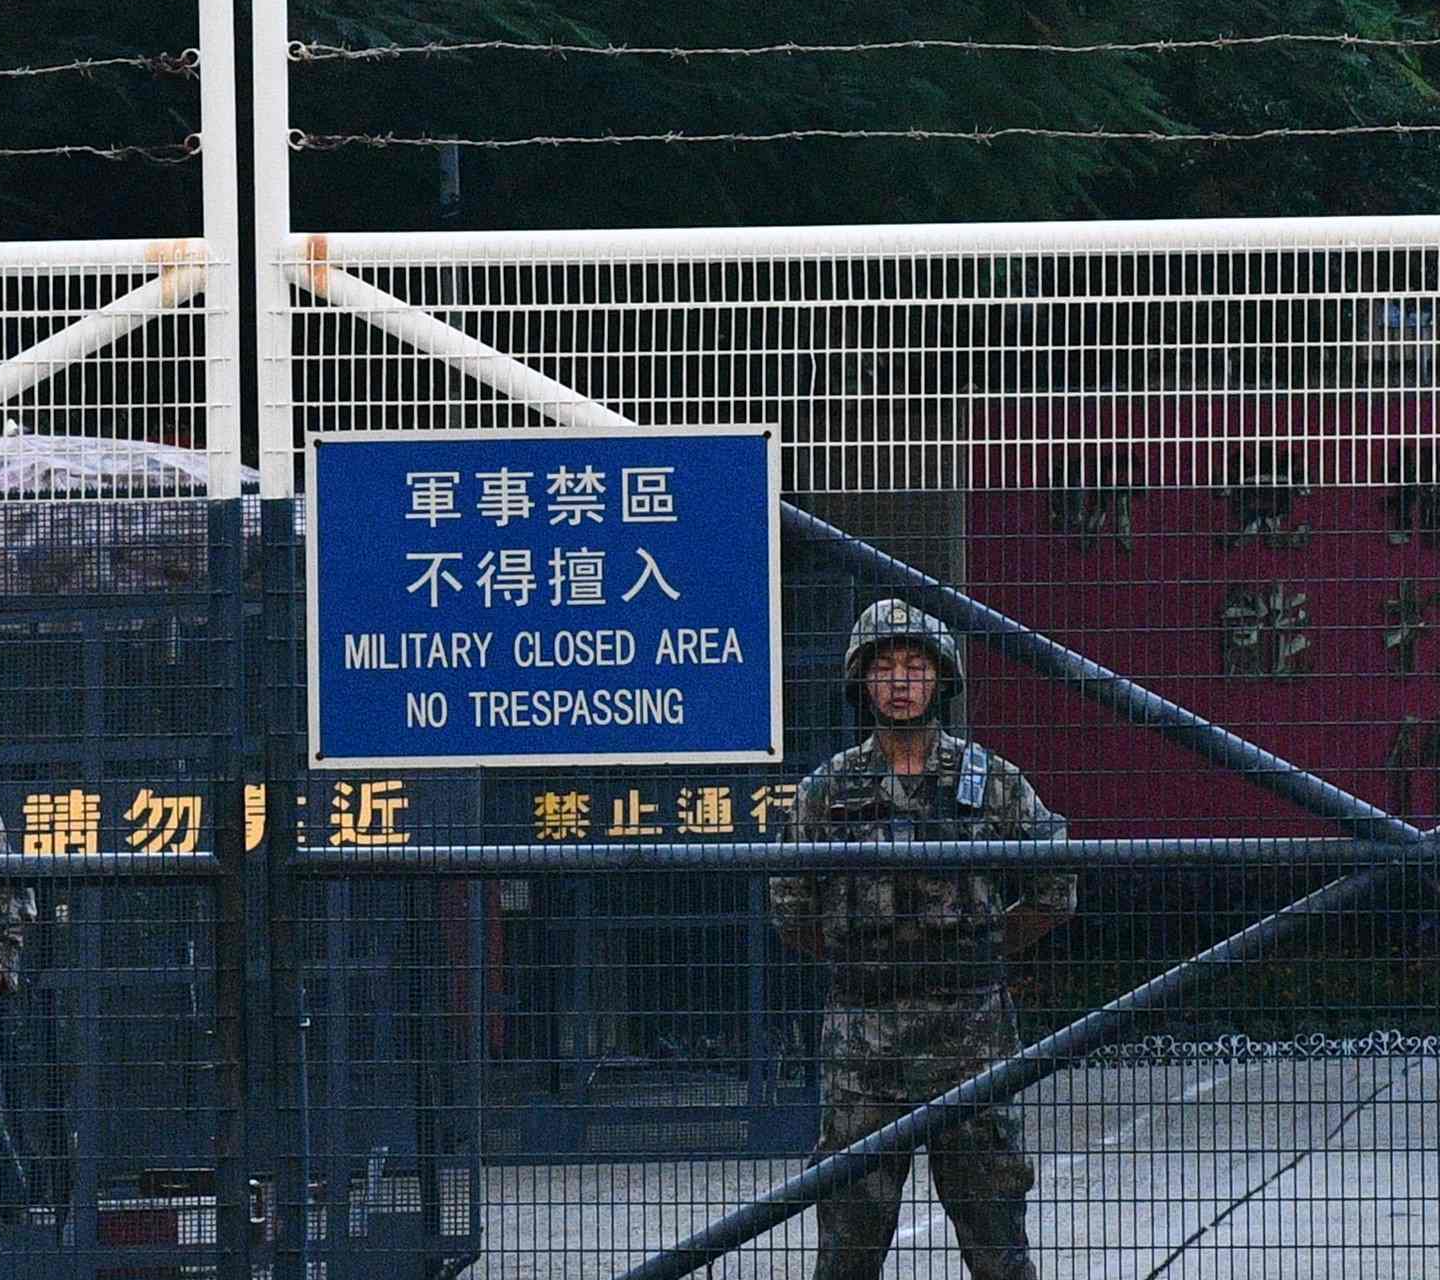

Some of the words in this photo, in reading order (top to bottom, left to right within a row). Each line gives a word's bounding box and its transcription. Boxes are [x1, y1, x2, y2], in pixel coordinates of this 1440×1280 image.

[404, 464, 678, 528] 軍事禁區
[405, 547, 681, 609] 不得擅入
[344, 631, 494, 670] MILITARY
[513, 628, 637, 669] CLOSED
[654, 626, 744, 666] AREA
[406, 692, 449, 729] NO
[468, 688, 684, 728] TRESPASSING
